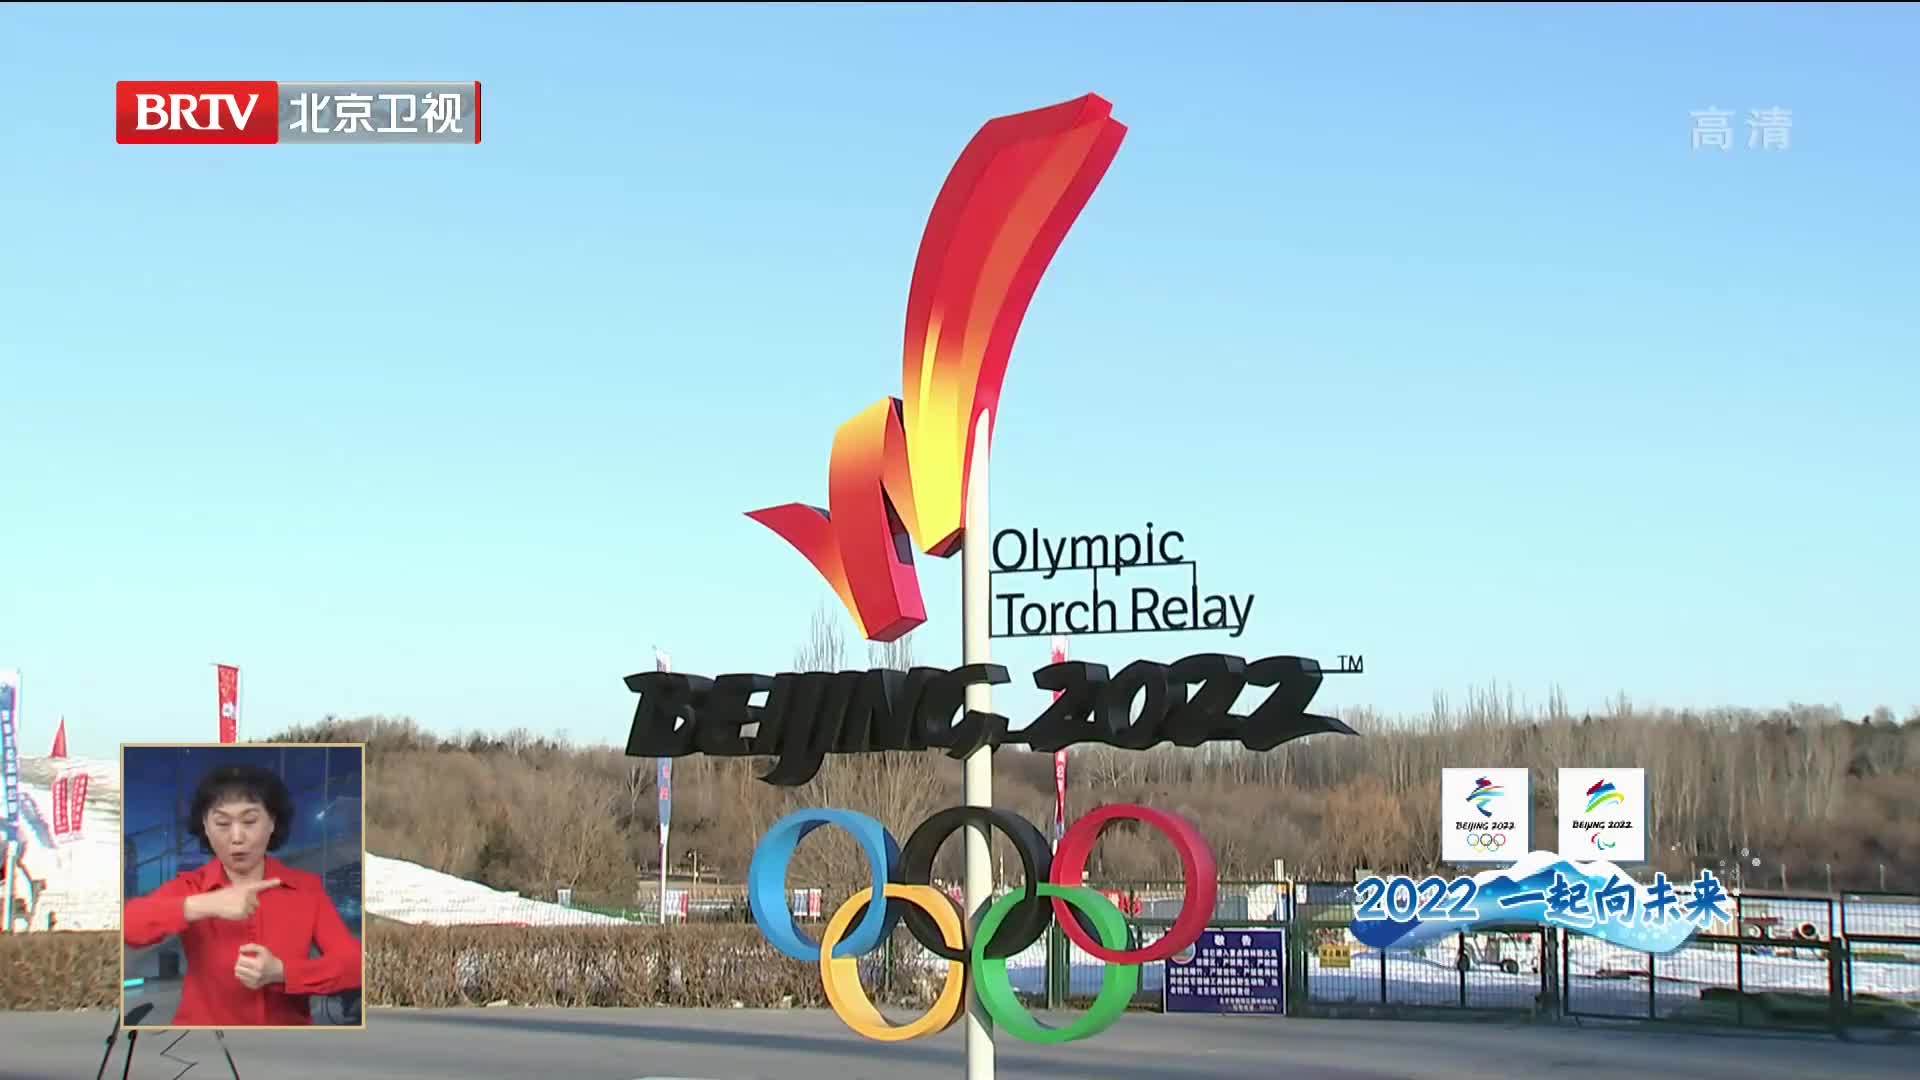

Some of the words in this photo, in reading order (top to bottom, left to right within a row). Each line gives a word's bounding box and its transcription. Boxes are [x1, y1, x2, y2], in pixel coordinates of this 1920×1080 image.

[992, 522, 1186, 580] Olympic
[996, 587, 1117, 636] Torch
[1131, 585, 1255, 638] Relay
[622, 663, 1012, 786] BEIJING
[1032, 652, 1360, 752] 2022
